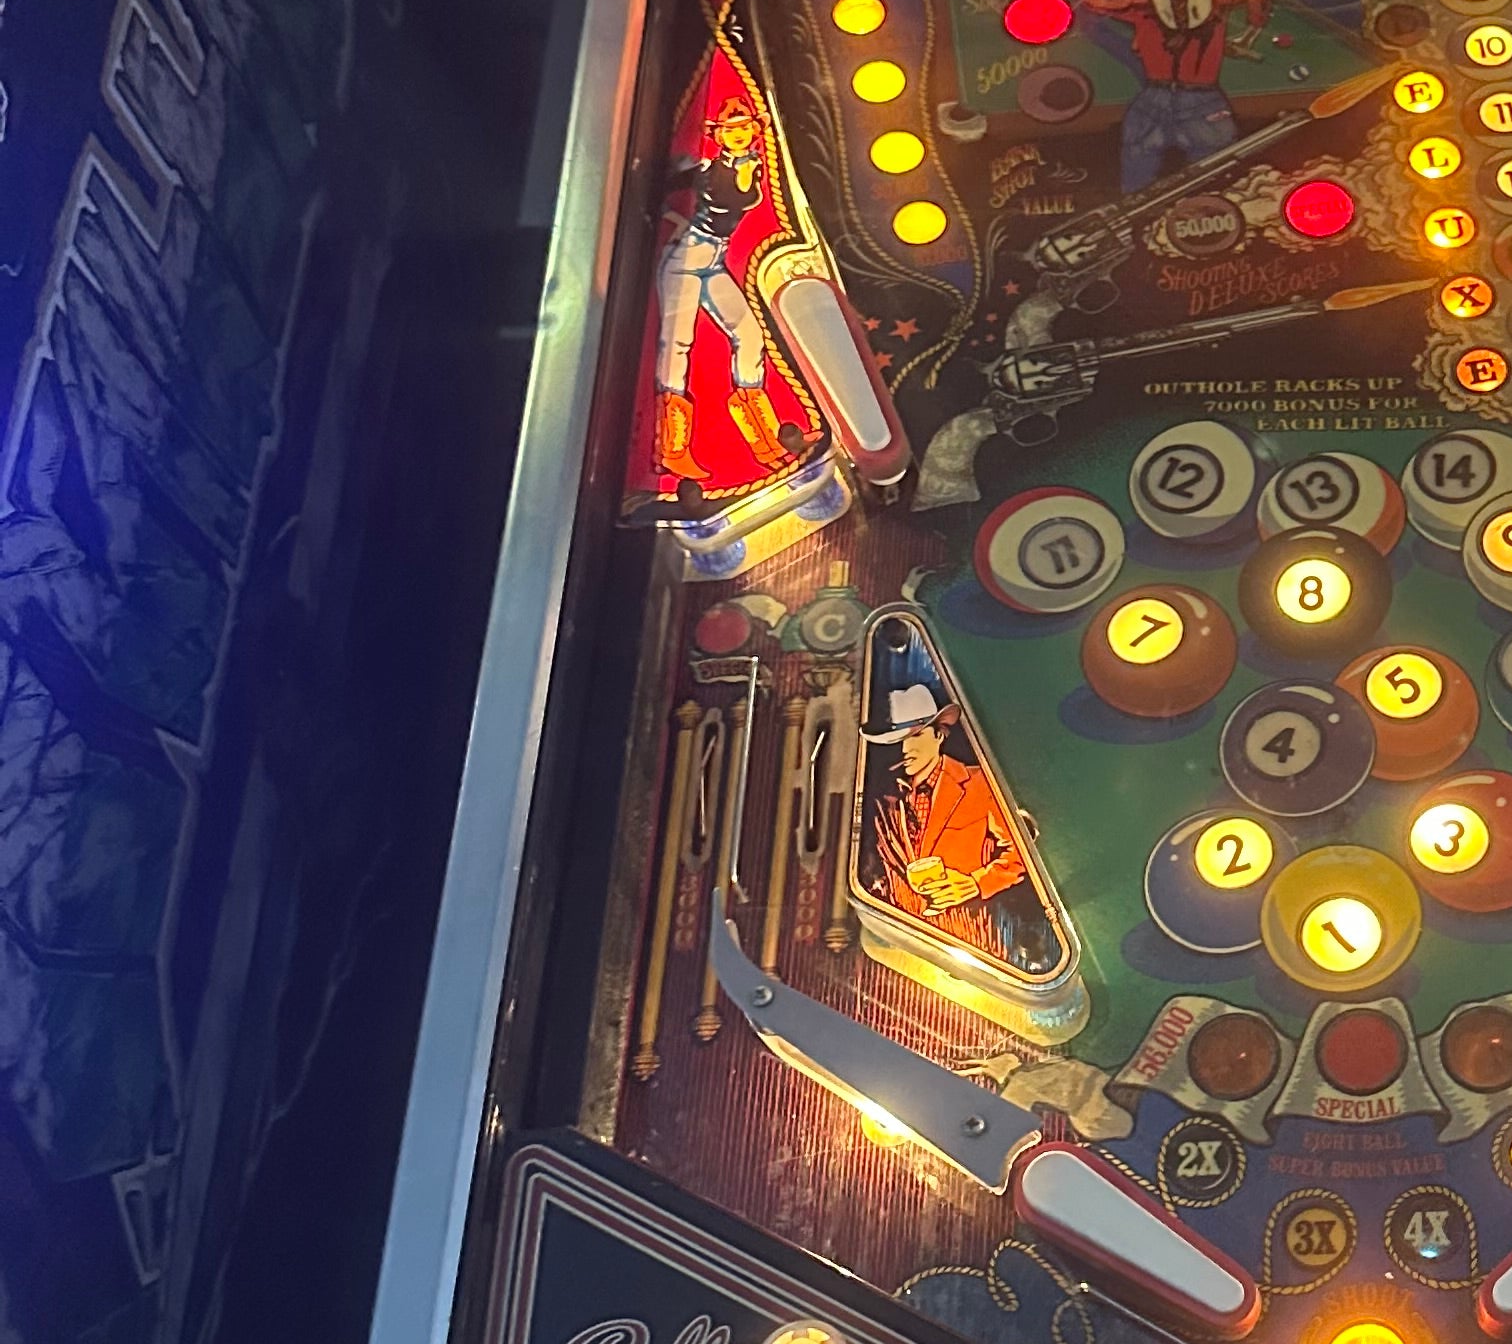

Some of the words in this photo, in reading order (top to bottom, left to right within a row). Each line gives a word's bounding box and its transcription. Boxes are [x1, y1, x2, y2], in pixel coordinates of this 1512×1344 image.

[1475, 36, 1506, 58] 10
[1404, 81, 1433, 104] E
[1422, 147, 1449, 168] L
[1175, 213, 1236, 238] 50,000
[1436, 216, 1465, 240] U
[1157, 256, 1251, 292] SHOOTING
[1188, 257, 1286, 316] DELUXE
[1260, 261, 1341, 304] SCORES
[1450, 283, 1486, 309] X
[1144, 380, 1268, 395] OUTHOLE
[1274, 378, 1361, 394] RACKS
[1368, 377, 1403, 391] UP
[1464, 358, 1498, 385] E
[1273, 398, 1361, 413] BONUS
[1368, 397, 1419, 410] FOR
[1257, 417, 1326, 431] EACH
[1335, 417, 1378, 430] LIT
[1385, 415, 1450, 429] BALL
[1157, 457, 1204, 499] 12
[1431, 453, 1476, 488] 14
[1289, 470, 1341, 511] 13
[1299, 575, 1323, 611] 8
[813, 613, 847, 643] C
[1128, 614, 1171, 648] 7
[1384, 666, 1422, 706] 5
[1262, 727, 1296, 763] 4
[1216, 833, 1252, 876] 2
[1434, 819, 1465, 857] 3
[1321, 920, 1358, 954] 1
[1135, 1006, 1194, 1082] 56,000
[1315, 1096, 1400, 1120] SPECIAL
[1176, 1140, 1223, 1178] 2X
[1292, 1221, 1337, 1257] 3X
[1404, 1210, 1450, 1248] 4X
